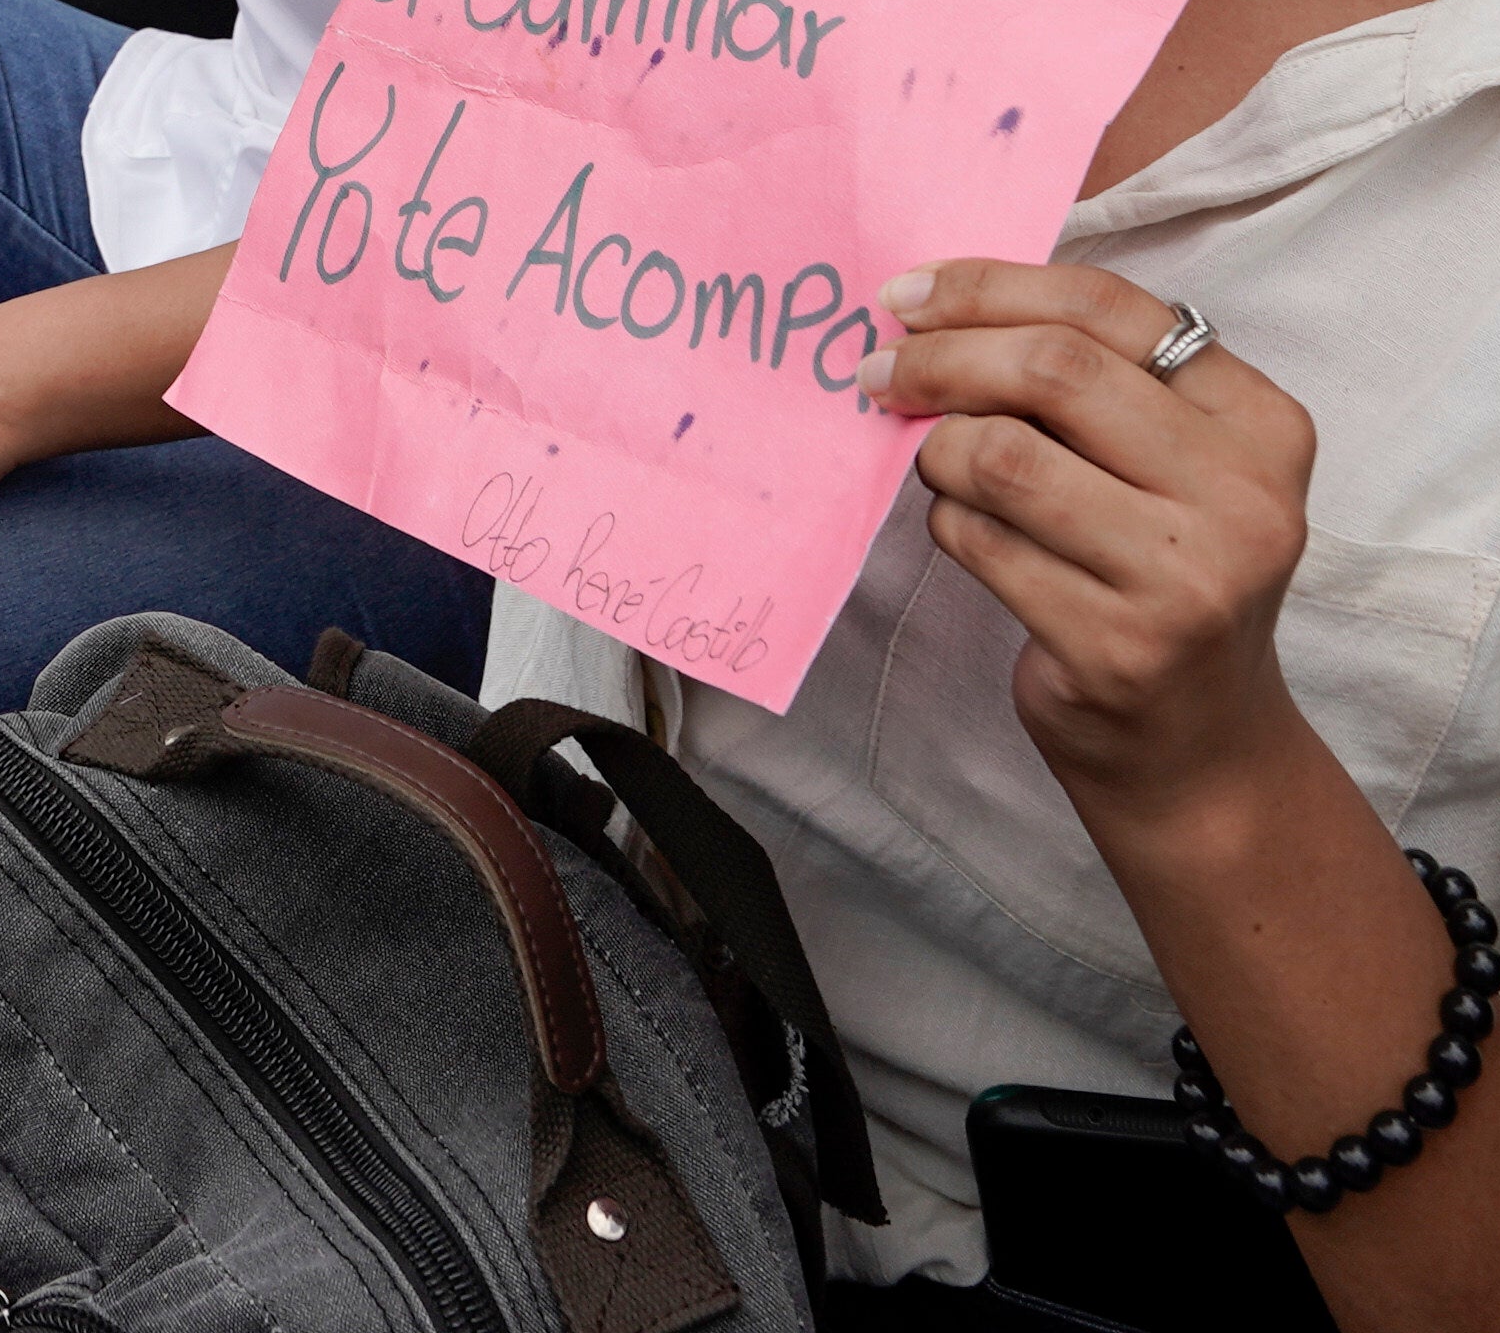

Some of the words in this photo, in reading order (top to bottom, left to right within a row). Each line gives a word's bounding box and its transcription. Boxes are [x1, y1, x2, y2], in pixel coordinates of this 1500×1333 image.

[506, 162, 888, 415] Acompa
[461, 471, 551, 583] Otto
[645, 564, 775, 673] Castillo
